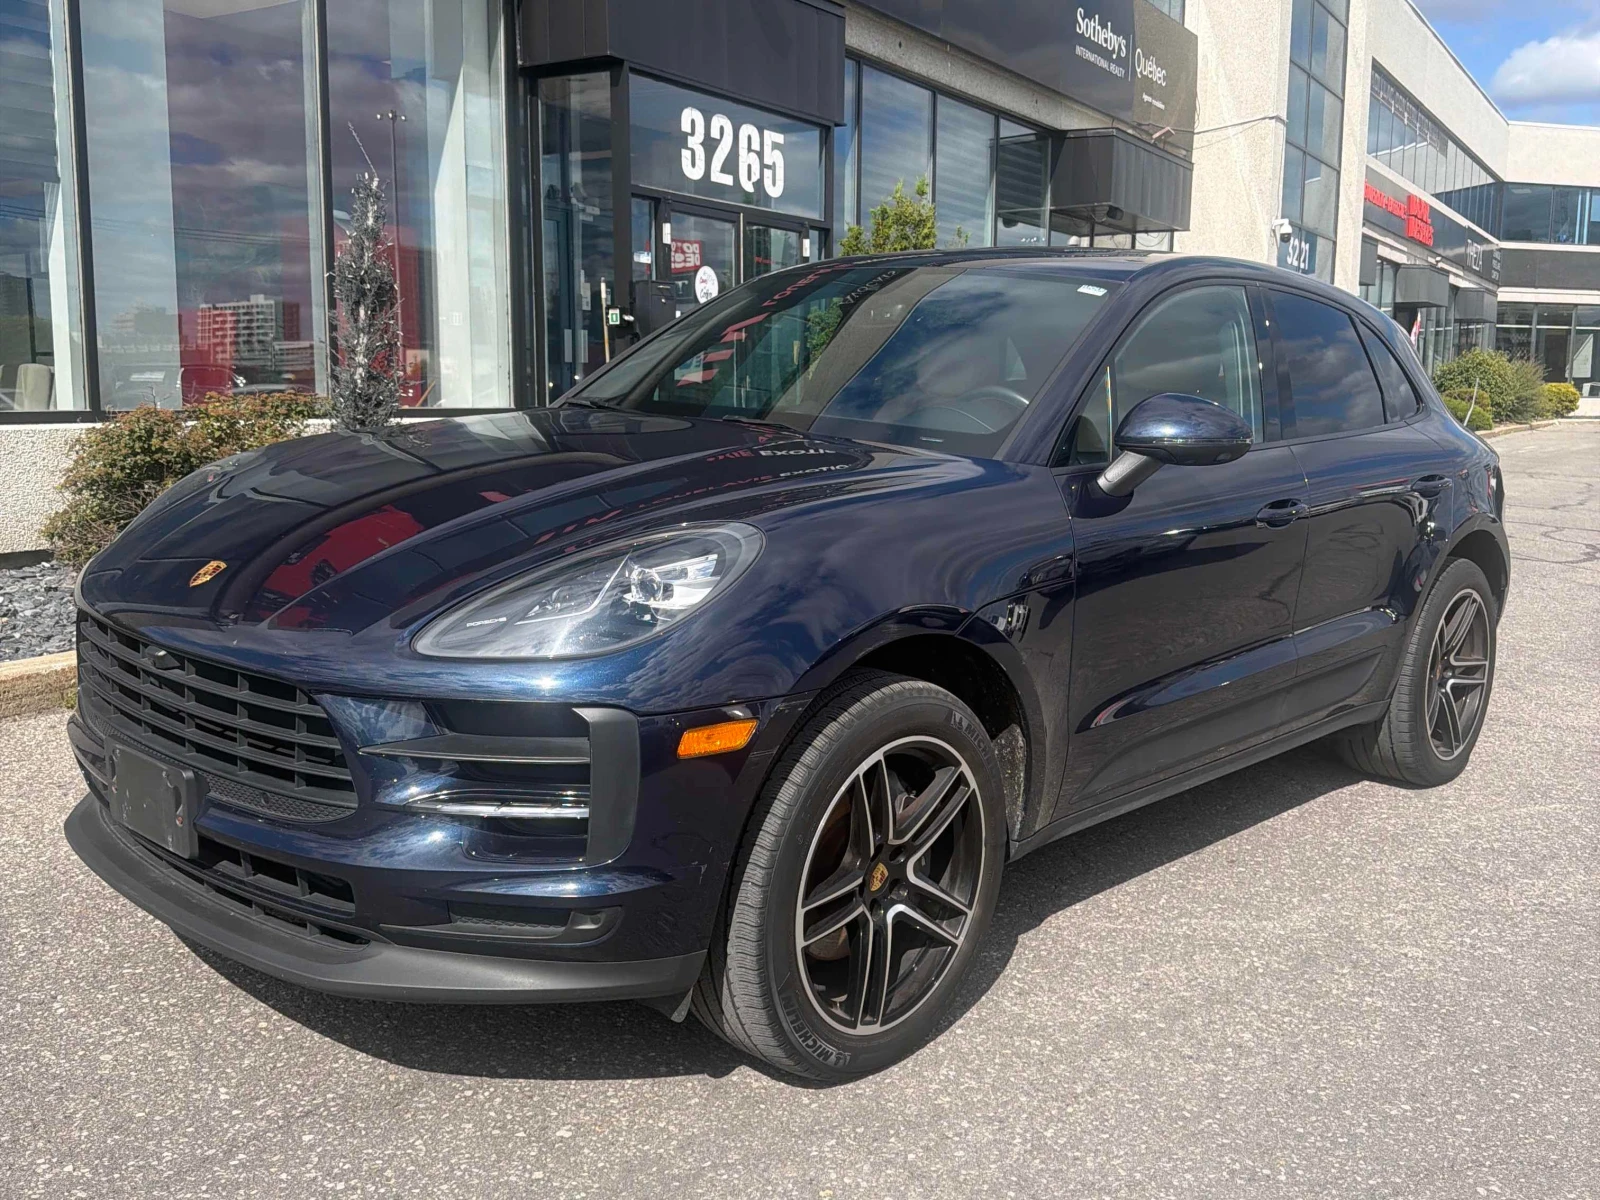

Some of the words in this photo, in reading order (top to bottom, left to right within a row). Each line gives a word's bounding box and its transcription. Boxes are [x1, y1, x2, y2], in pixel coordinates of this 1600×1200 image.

[1076, 7, 1127, 60] Sotheby's
[1075, 44, 1110, 72] INTERNATIONAL
[1110, 62, 1125, 79] REALTY
[1135, 48, 1167, 87] Québec
[680, 106, 785, 199] 3265
[1286, 236, 1310, 271] 3221
[466, 616, 507, 628] PORSCHE
[781, 994, 836, 1064] MICHELIN
